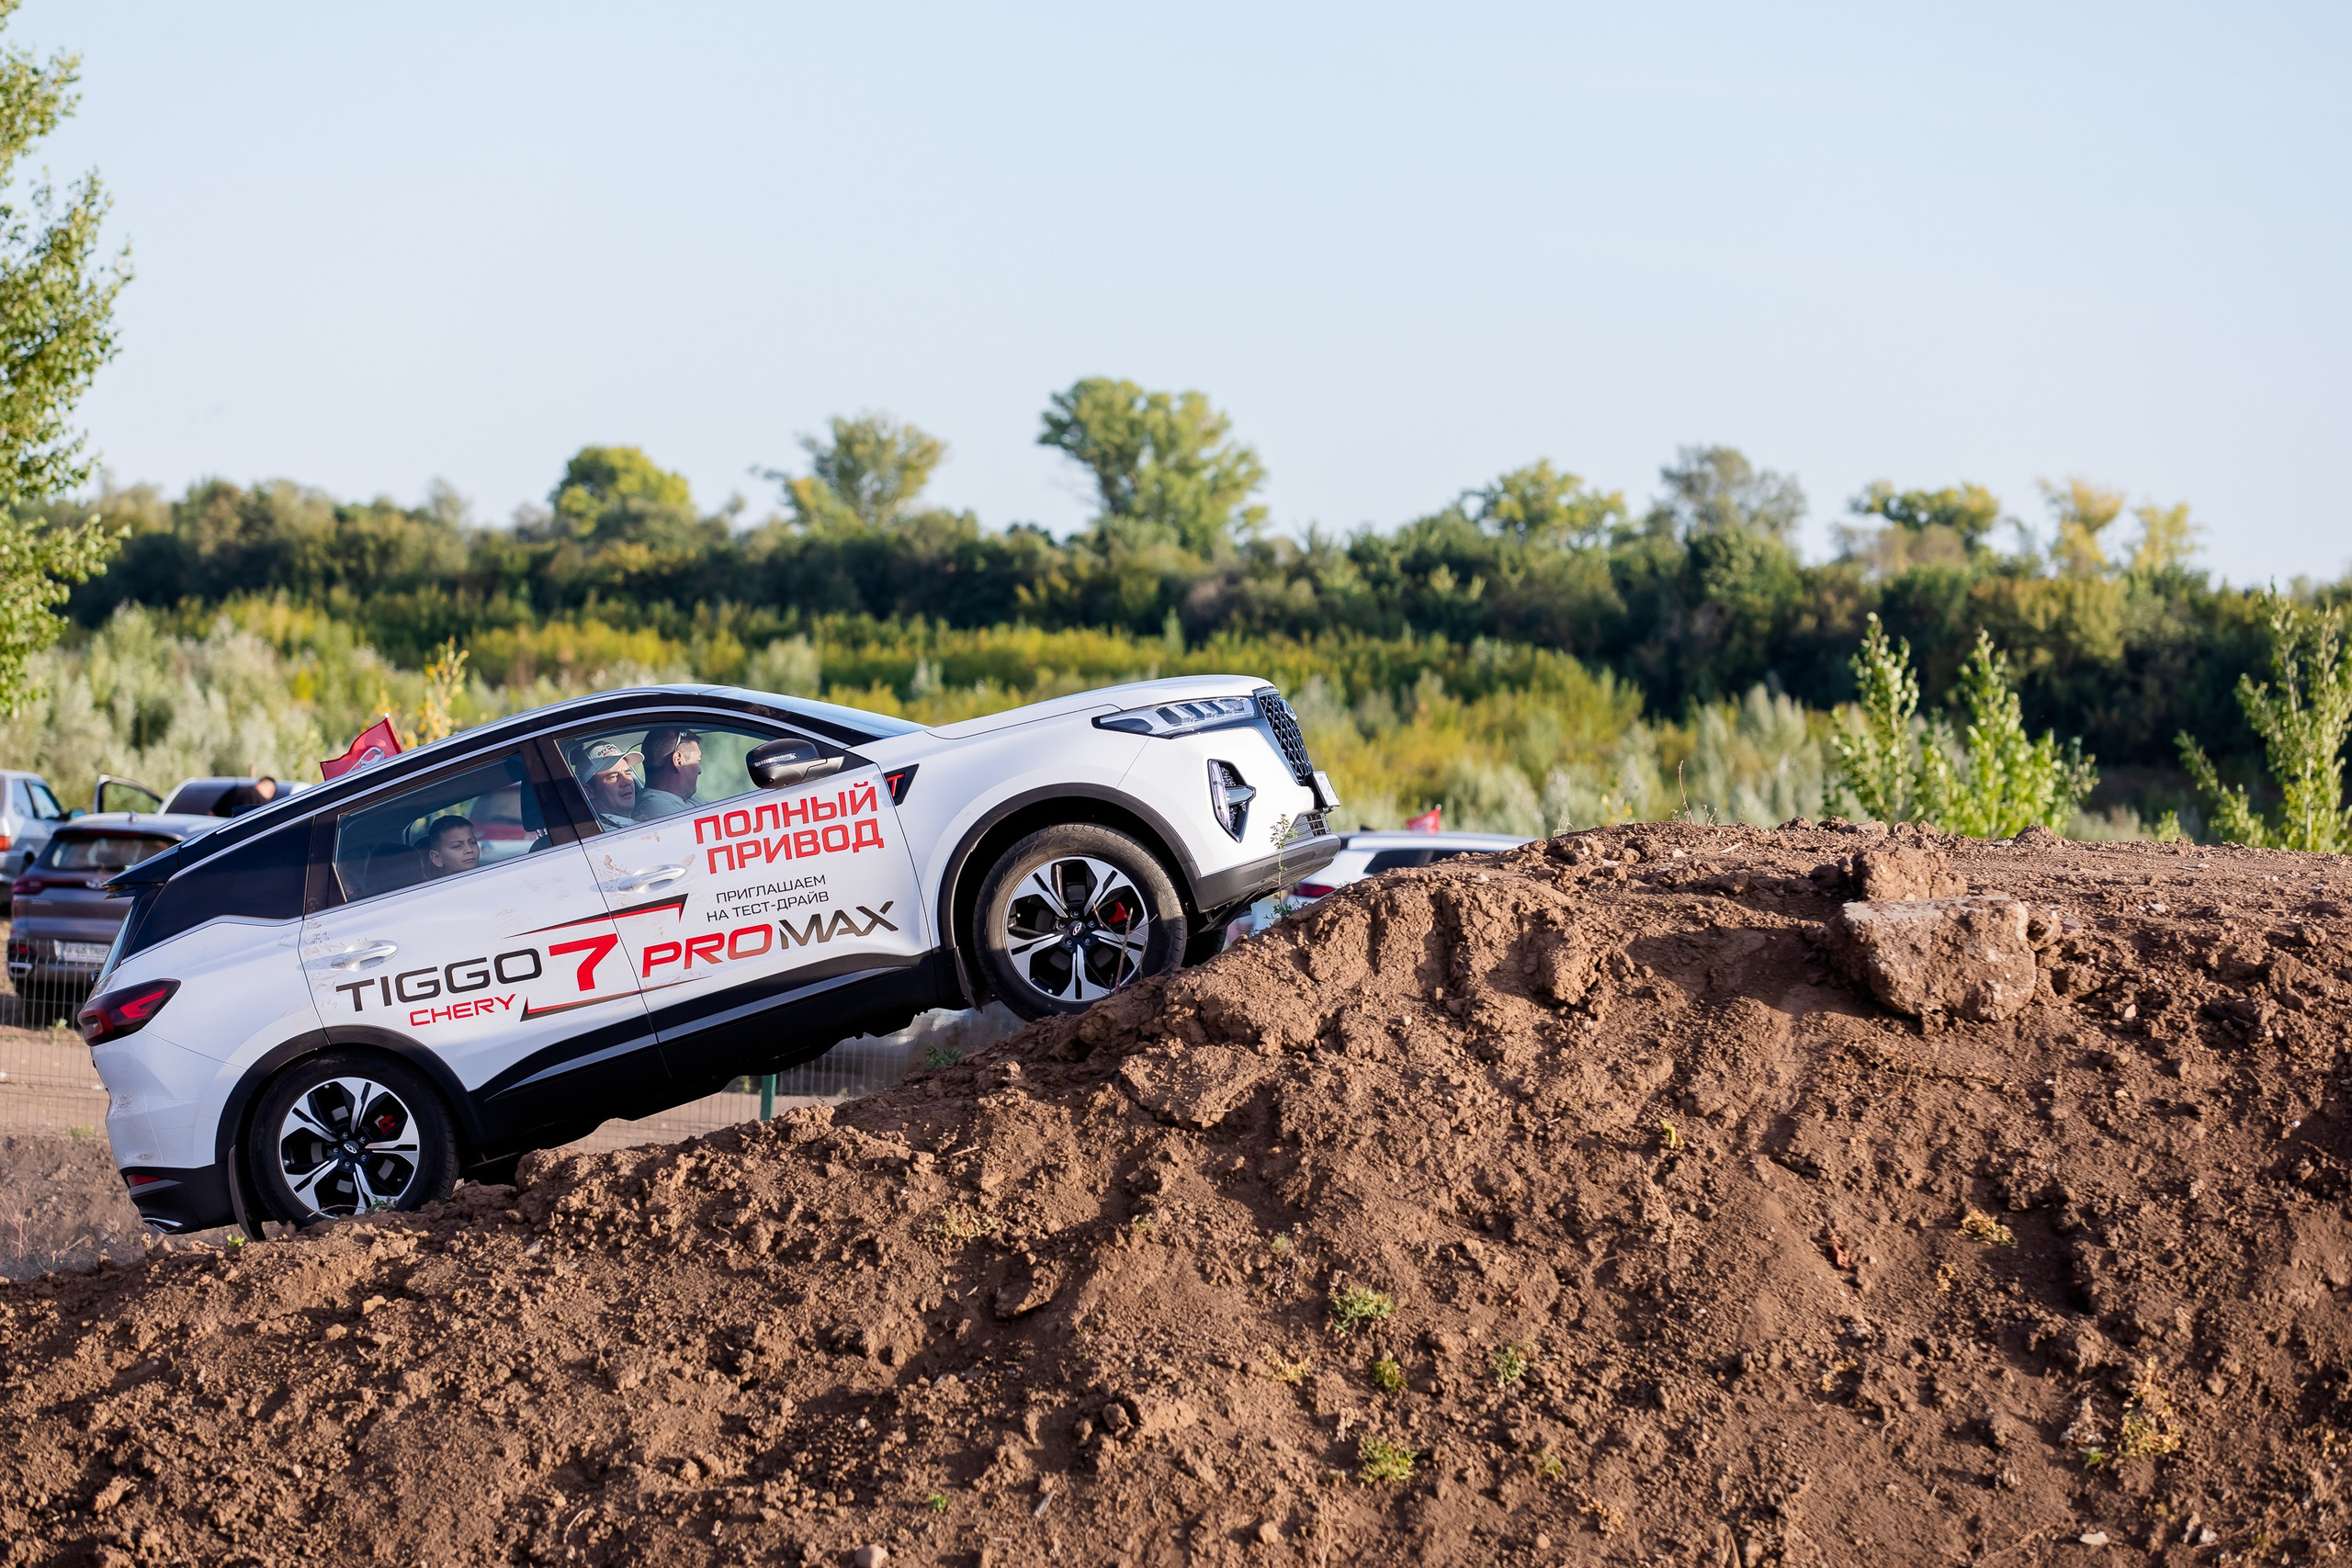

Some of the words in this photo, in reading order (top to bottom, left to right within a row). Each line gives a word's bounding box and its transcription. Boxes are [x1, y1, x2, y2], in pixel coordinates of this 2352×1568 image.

[694, 781, 878, 845] ПОЛНЫЙ
[707, 818, 885, 874] ПРИВОД
[707, 909, 729, 923] НА
[731, 890, 830, 918] ТЕСТ-ДРАЙВ
[716, 874, 827, 904] ПРИГЛАШАЕМ
[335, 948, 543, 1012] TIGGO
[548, 932, 619, 992] 7
[409, 993, 516, 1027] CHERY
